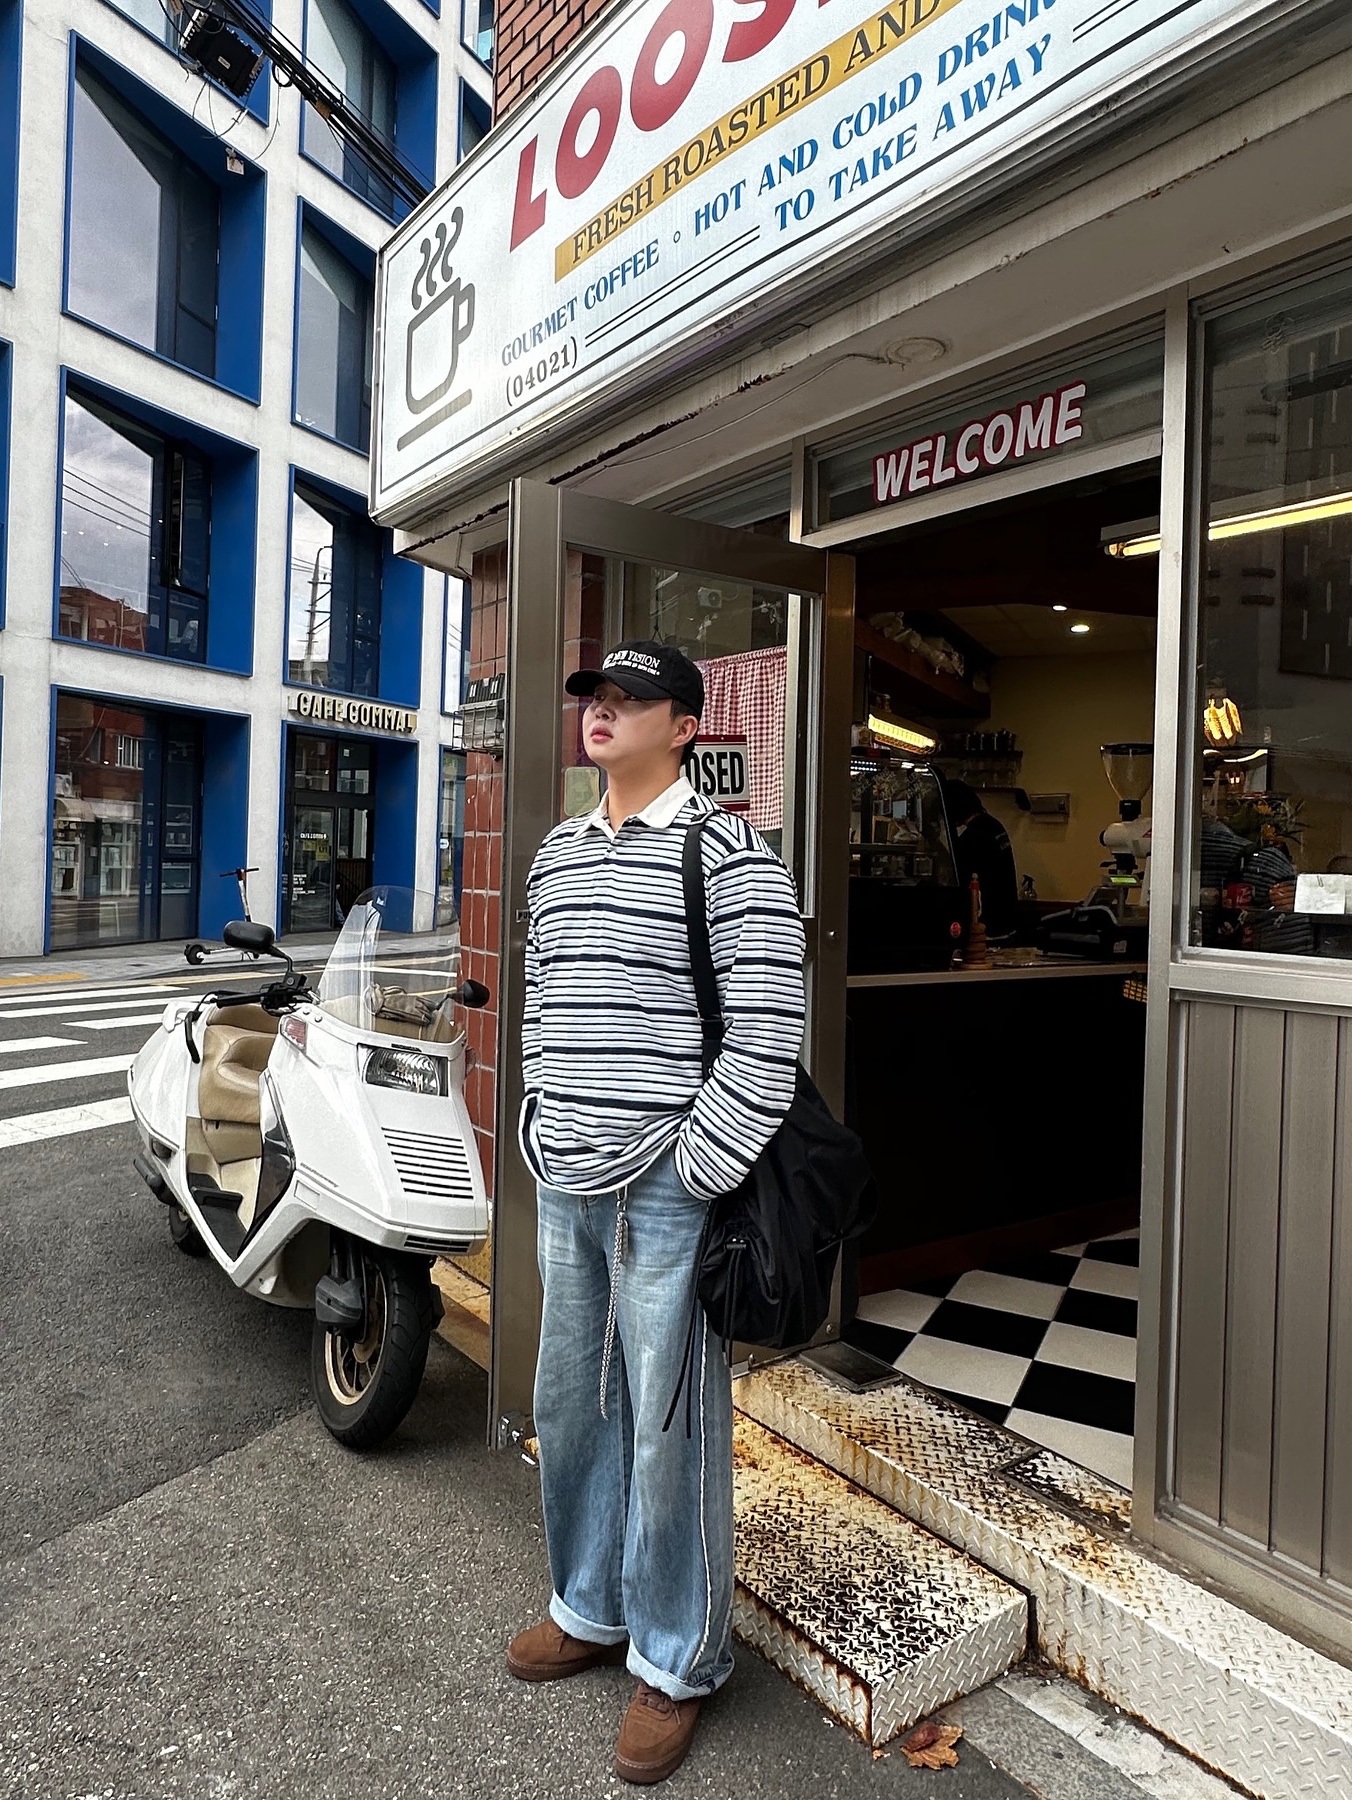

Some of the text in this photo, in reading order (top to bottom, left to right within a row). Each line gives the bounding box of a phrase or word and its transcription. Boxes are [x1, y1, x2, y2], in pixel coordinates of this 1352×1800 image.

[510, 0, 834, 253] LOOS
[572, 0, 940, 264] FRESH ROASTED AND
[774, 33, 1051, 231] TO TAKE AWAY
[501, 297, 578, 367] GOURMET
[584, 239, 660, 311] COFFEE
[694, 180, 746, 237] HOT
[757, 138, 819, 197] AND
[832, 72, 922, 150] COLD
[505, 339, 579, 407] (04021)
[874, 382, 1086, 502] WELCOME
[298, 692, 344, 722] CAFE
[685, 751, 745, 796] OSED
